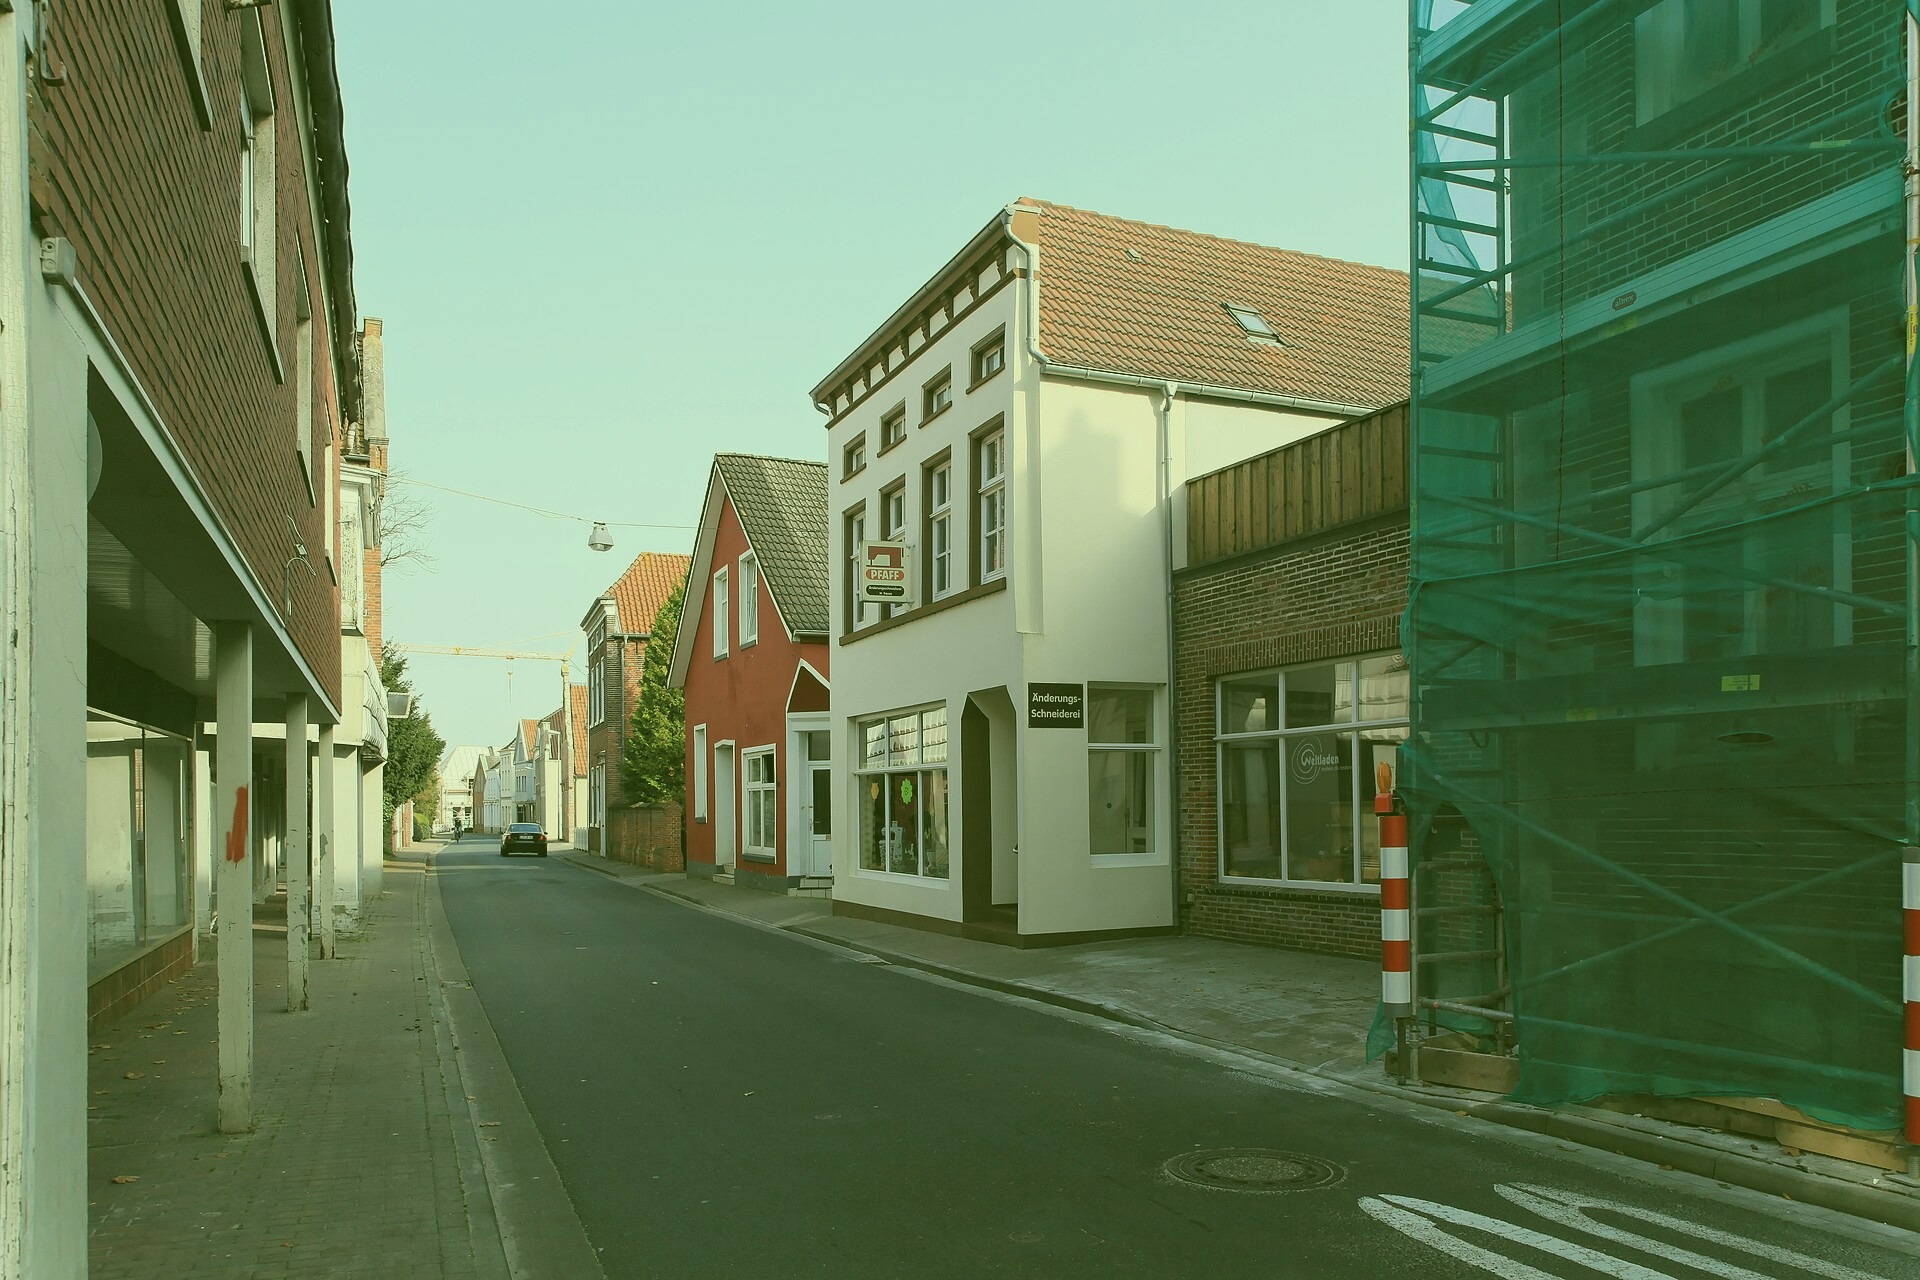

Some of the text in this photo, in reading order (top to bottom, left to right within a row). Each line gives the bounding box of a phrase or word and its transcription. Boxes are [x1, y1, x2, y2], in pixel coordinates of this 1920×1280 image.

[871, 570, 899, 580] PFAFF
[1032, 692, 1081, 704] Änderungs-
[1031, 708, 1080, 718] Schneiderei
